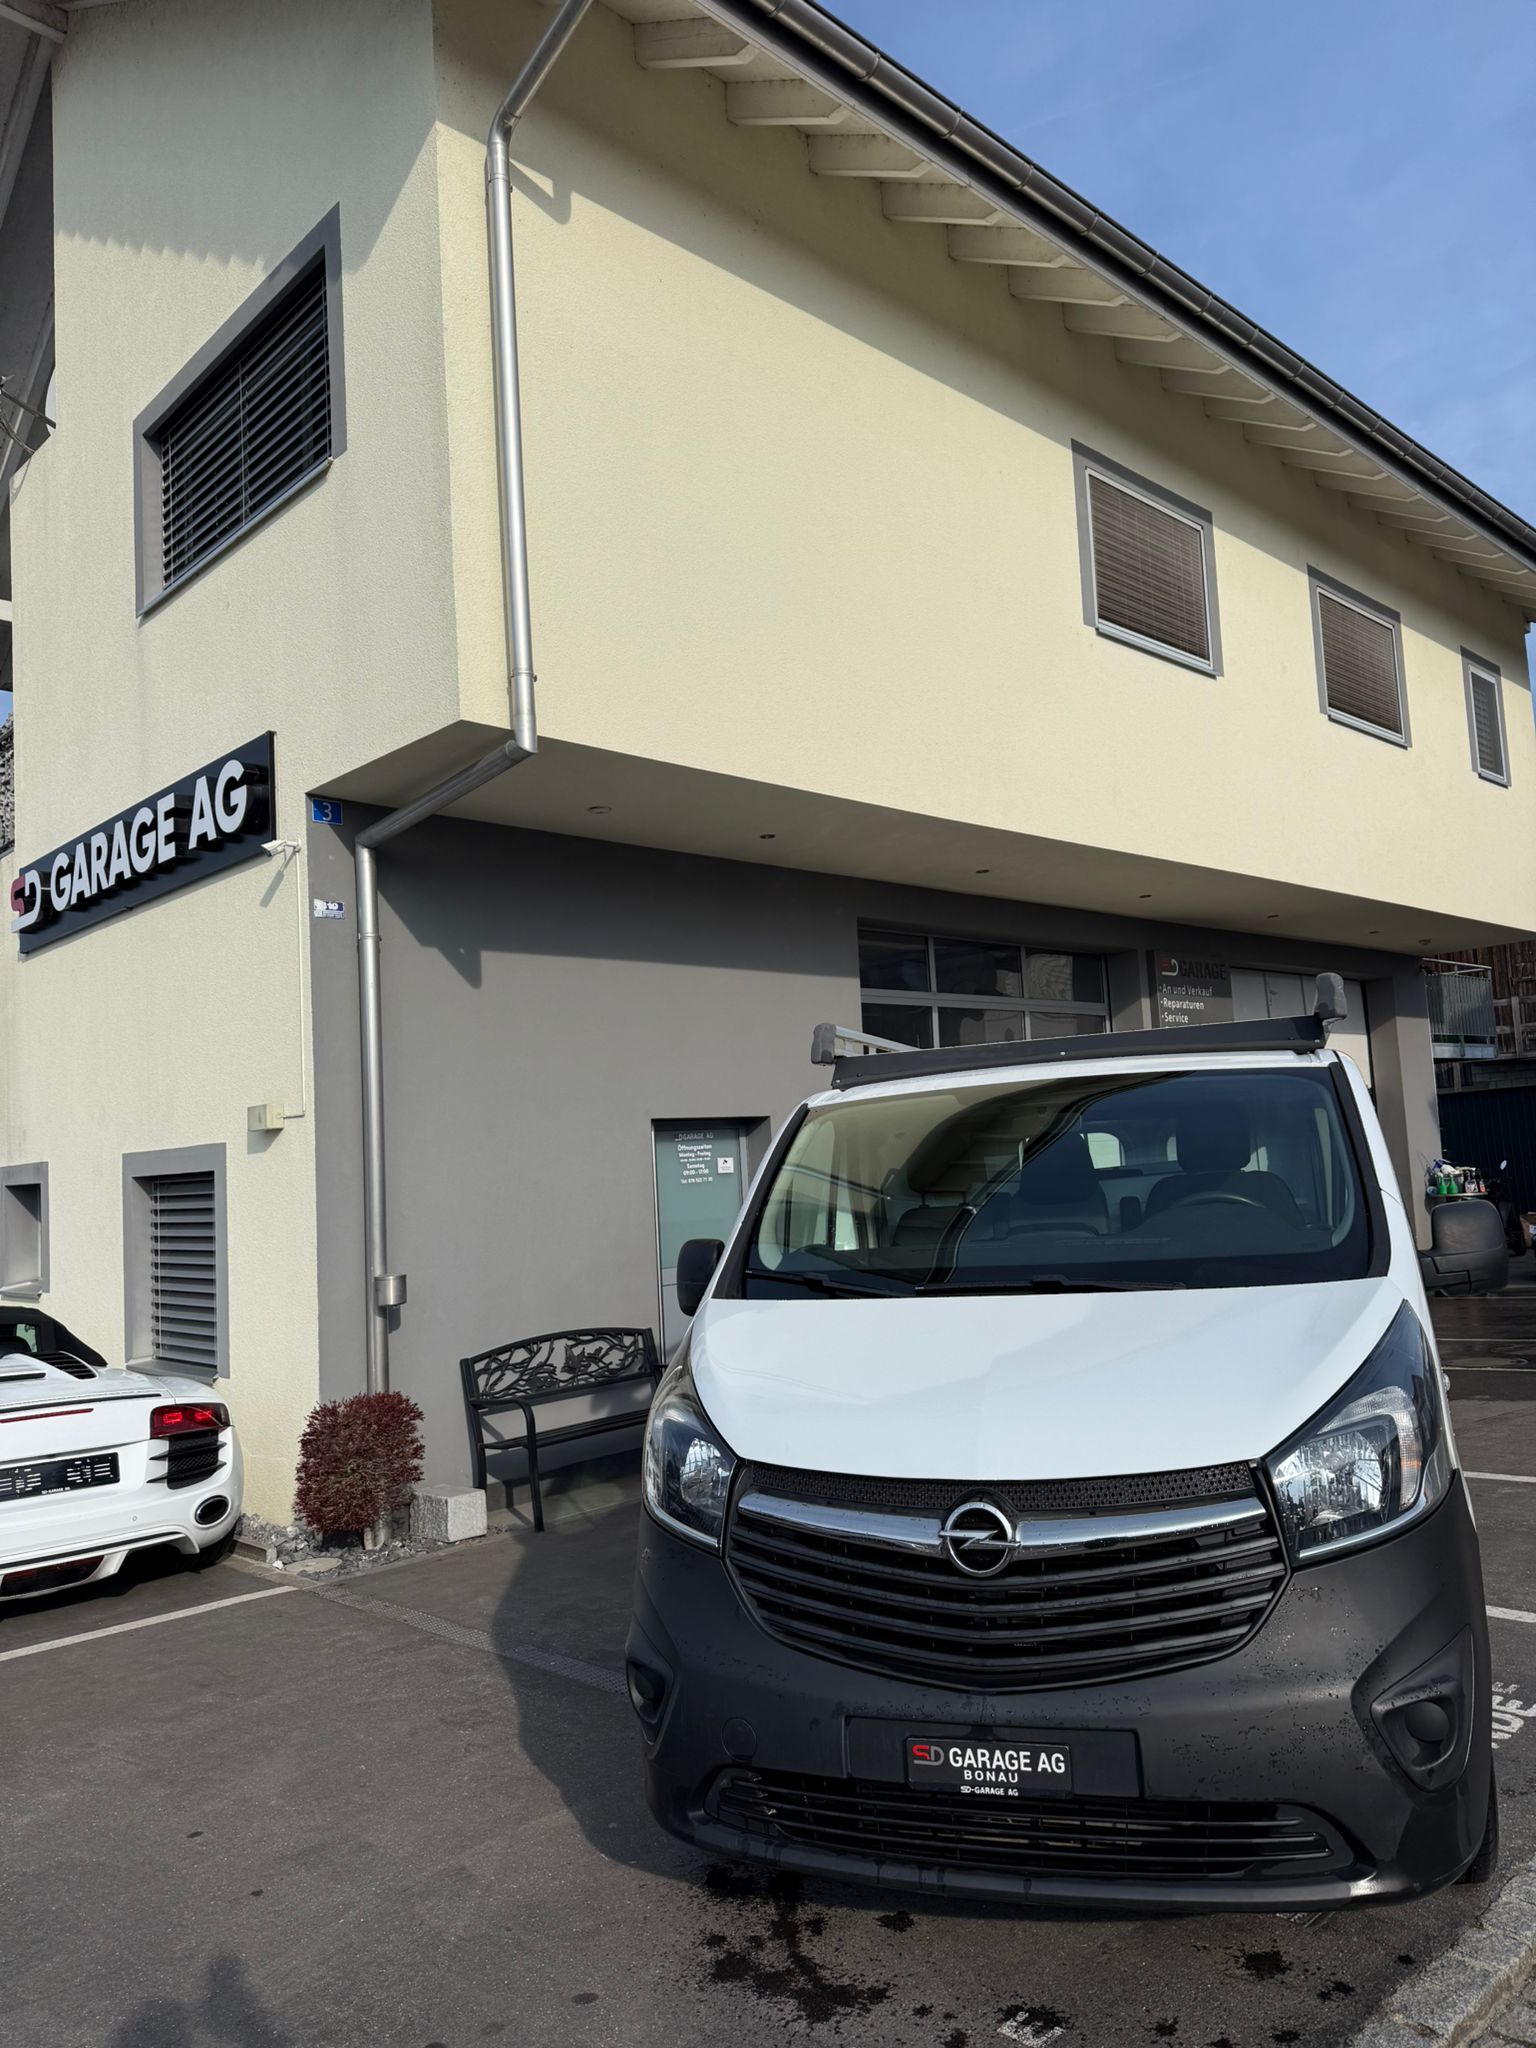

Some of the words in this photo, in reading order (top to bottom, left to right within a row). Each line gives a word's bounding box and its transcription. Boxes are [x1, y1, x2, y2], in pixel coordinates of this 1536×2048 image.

[322, 802, 332, 821] 3
[50, 792, 175, 912] GARAGE
[188, 759, 247, 850] AG
[1179, 962, 1227, 980] GARAGE
[1173, 984, 1186, 995] und
[1187, 985, 1213, 997] Verkauf
[1163, 998, 1205, 1011] Reparaturen
[1164, 1012, 1189, 1023] Service
[912, 1744, 944, 1767] SD
[949, 1747, 1032, 1772] GARAGE
[1037, 1752, 1065, 1773] AG
[964, 1770, 1018, 1783] BONAU
[960, 1785, 1005, 1796] SD-GARAGE
[1007, 1789, 1019, 1797] AG
